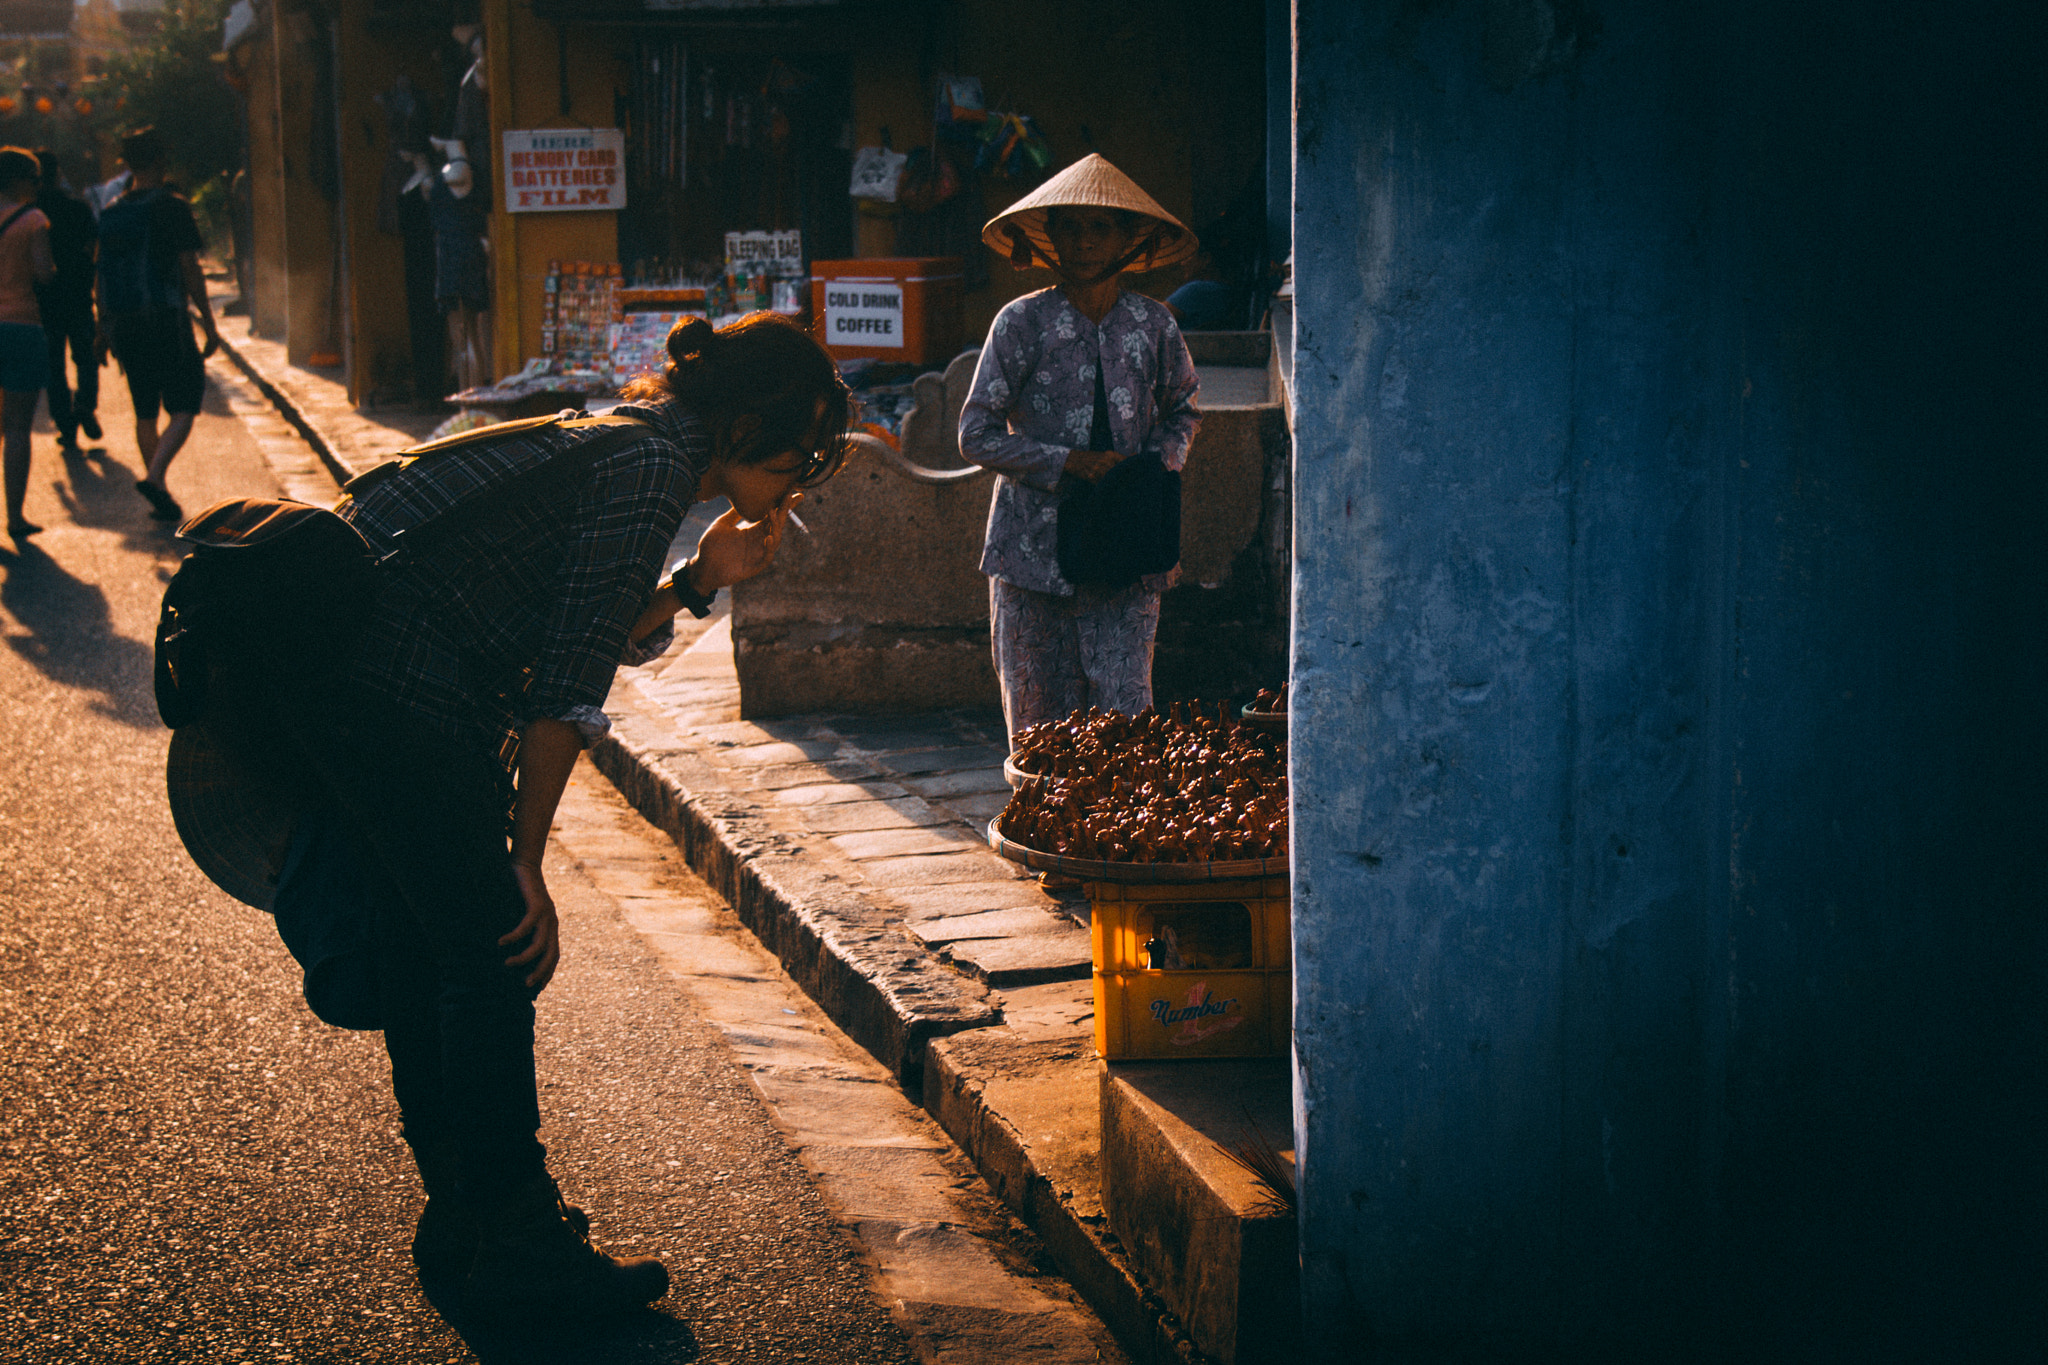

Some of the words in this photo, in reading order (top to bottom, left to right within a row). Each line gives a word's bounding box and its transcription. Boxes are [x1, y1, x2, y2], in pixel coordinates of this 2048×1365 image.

[511, 150, 574, 168] MEMORY
[577, 149, 617, 167] CARD
[512, 168, 617, 187] BATTERIES
[518, 188, 611, 206] FILM
[727, 239, 776, 259] SLEEPING
[777, 238, 799, 258] BAG
[828, 292, 859, 308] COLD
[862, 293, 900, 310] DRINK
[836, 317, 893, 334] COFFEE
[1150, 991, 1238, 1028] Number
